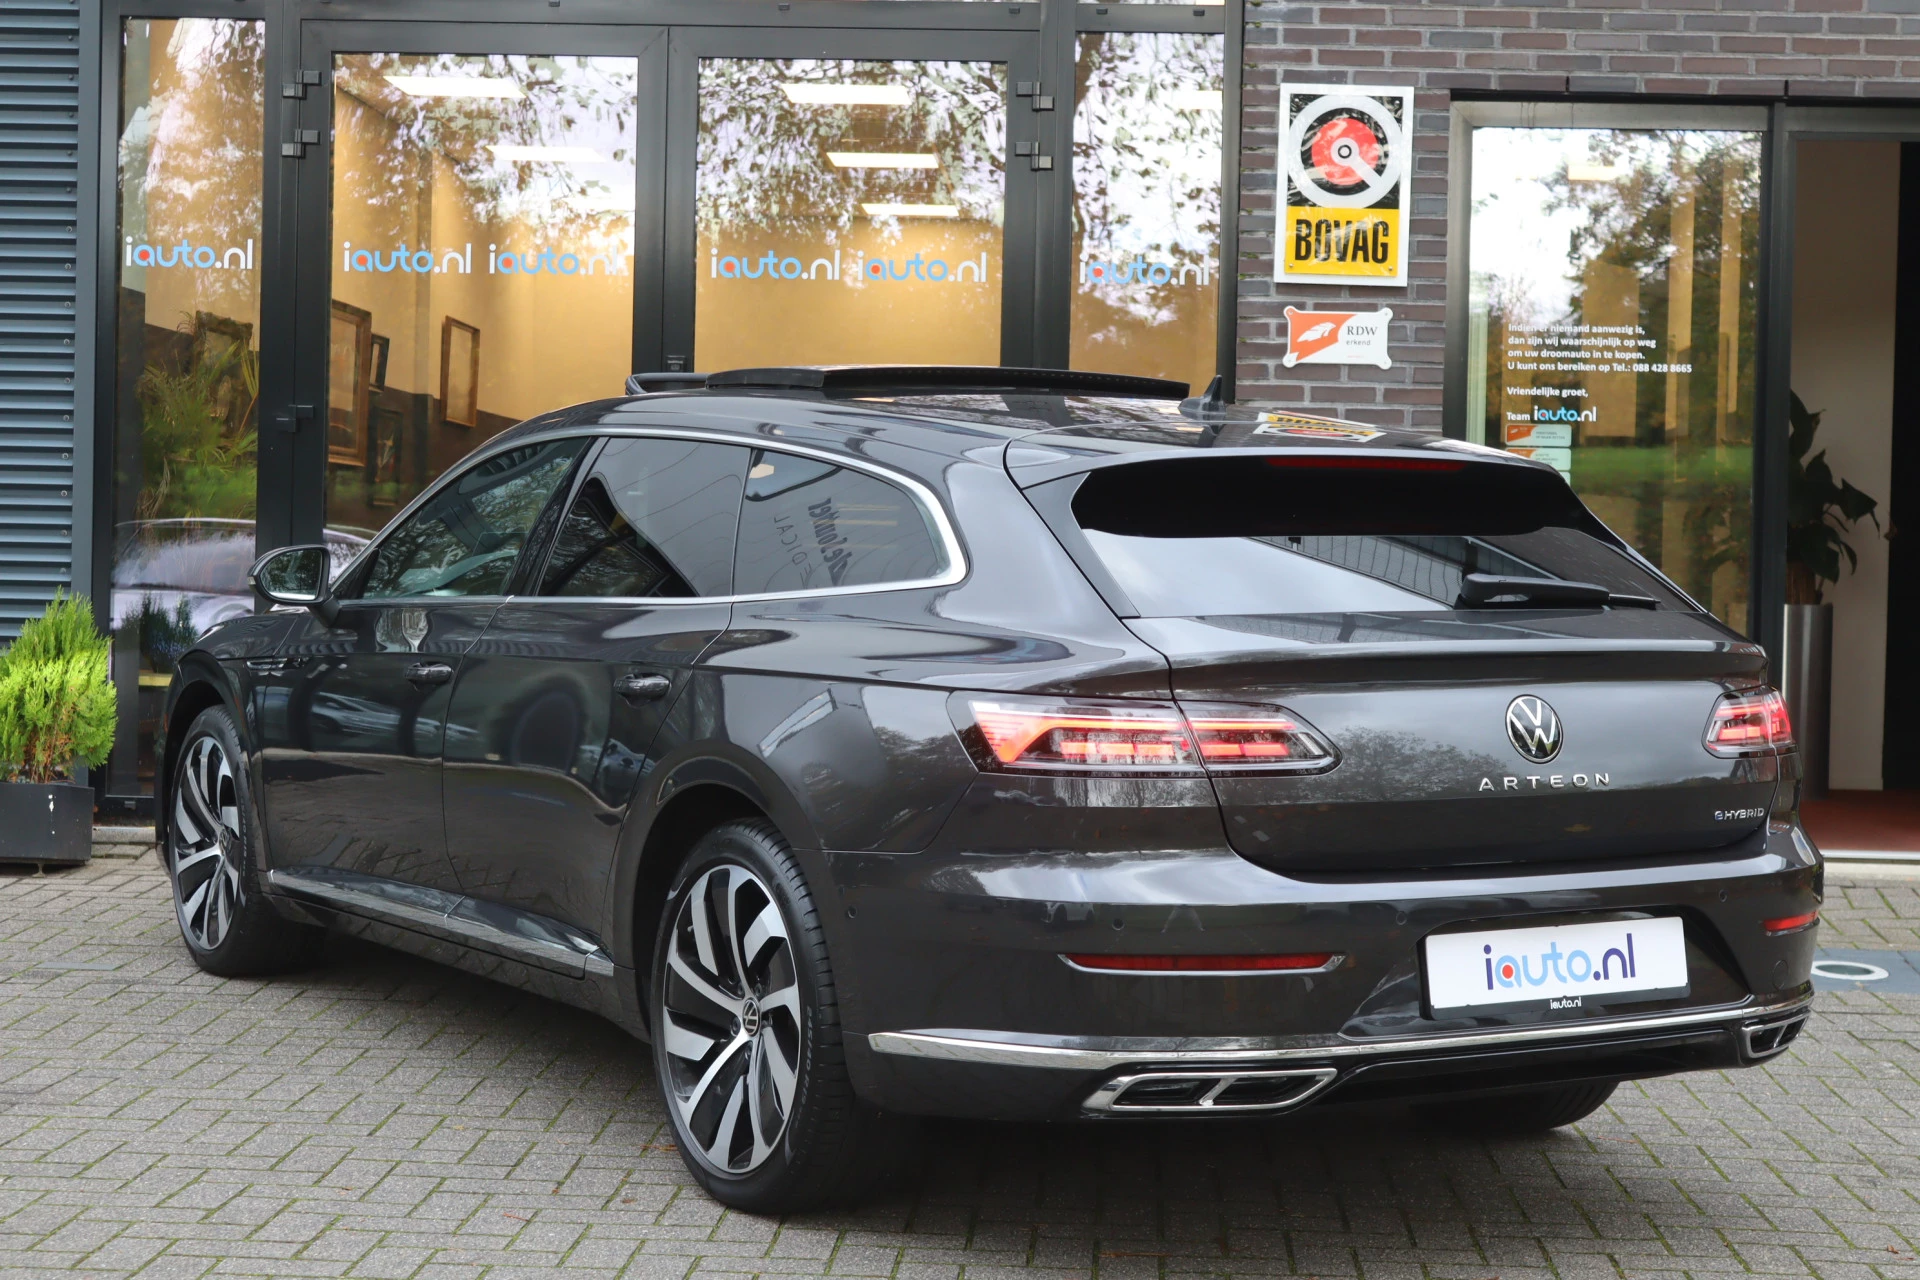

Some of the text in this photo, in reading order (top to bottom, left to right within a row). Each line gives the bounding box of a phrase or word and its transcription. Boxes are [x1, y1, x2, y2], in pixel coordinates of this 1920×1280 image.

[1295, 219, 1389, 264] BOVAG
[125, 236, 254, 270] iauto.nl
[343, 241, 472, 274] iauto.nl
[489, 244, 618, 276] iauto.nl
[711, 248, 841, 281] iauto.nl
[857, 250, 987, 283] iauto.nl
[1079, 252, 1210, 286] iauto.nl
[1347, 325, 1378, 336] RDW
[1550, 324, 1590, 333] niemand
[1591, 325, 1634, 335] aanwezig
[1635, 325, 1646, 335] is,
[1508, 336, 1657, 349] dan zijn wij waarschijnlijk op weg
[1540, 349, 1591, 358] droomauto
[1592, 350, 1602, 359] in
[1603, 351, 1613, 359] te
[1615, 351, 1646, 361] kopen.
[1507, 362, 1515, 370] U
[1516, 362, 1537, 370] kunt
[1557, 362, 1597, 371] bereiken
[1598, 365, 1611, 373] op
[1612, 363, 1631, 372] Tel.:
[1632, 363, 1650, 373] 088
[1651, 363, 1669, 373] 428
[1669, 364, 1693, 374] 8665
[1506, 386, 1589, 398] Vriendelijke groet,
[1506, 405, 1597, 422] Team iauto.nl
[1478, 772, 1611, 793] ARTEON
[1483, 933, 1636, 990] iauto.nl
[1550, 995, 1582, 1010] iauto.nl
